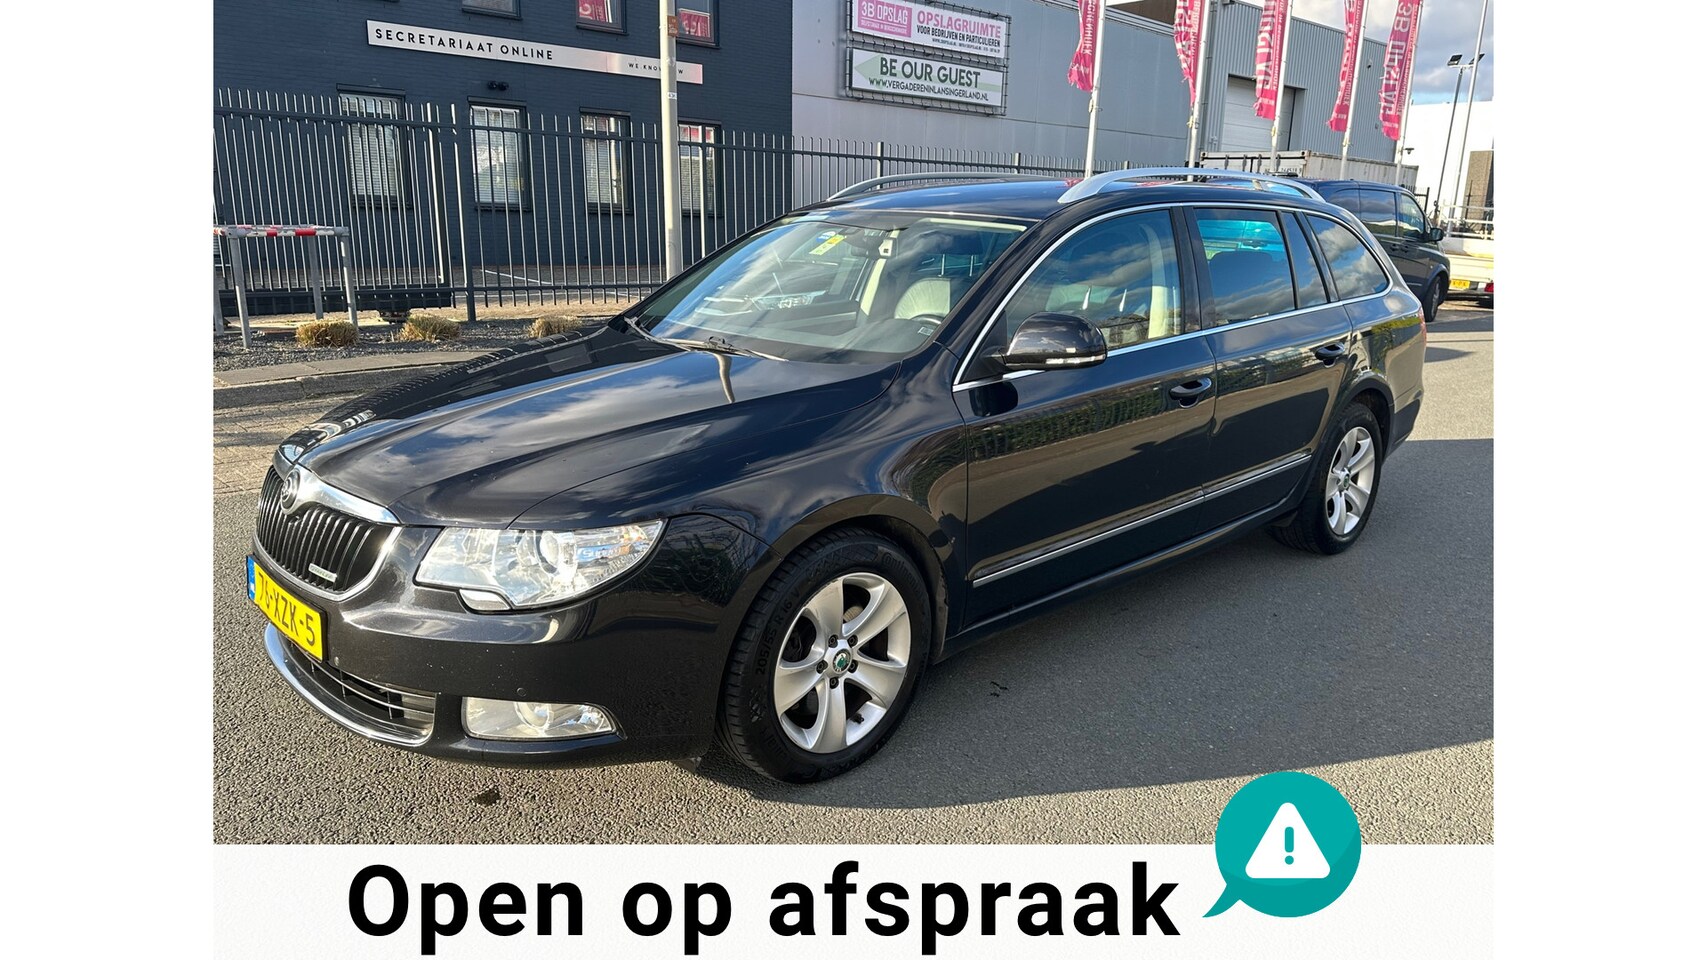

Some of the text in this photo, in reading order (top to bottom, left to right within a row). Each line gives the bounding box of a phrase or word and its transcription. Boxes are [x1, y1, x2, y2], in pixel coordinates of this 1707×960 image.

[861, 2, 908, 25] 3B OPSLAG
[917, 10, 1001, 39] OPSLAGRUIMTE
[375, 28, 553, 60] SECRETARIAAT ONLINE
[917, 25, 930, 36] VOOR
[931, 26, 958, 40] BEDRIJVEN
[958, 31, 966, 42] EN
[965, 32, 1001, 48] PARTICULIEREN
[880, 56, 981, 88] BE OUR GUEST
[868, 77, 989, 102] WWW.VERGADERENINLANSINGERLAND.NL
[258, 571, 316, 647] 76-XZK-5
